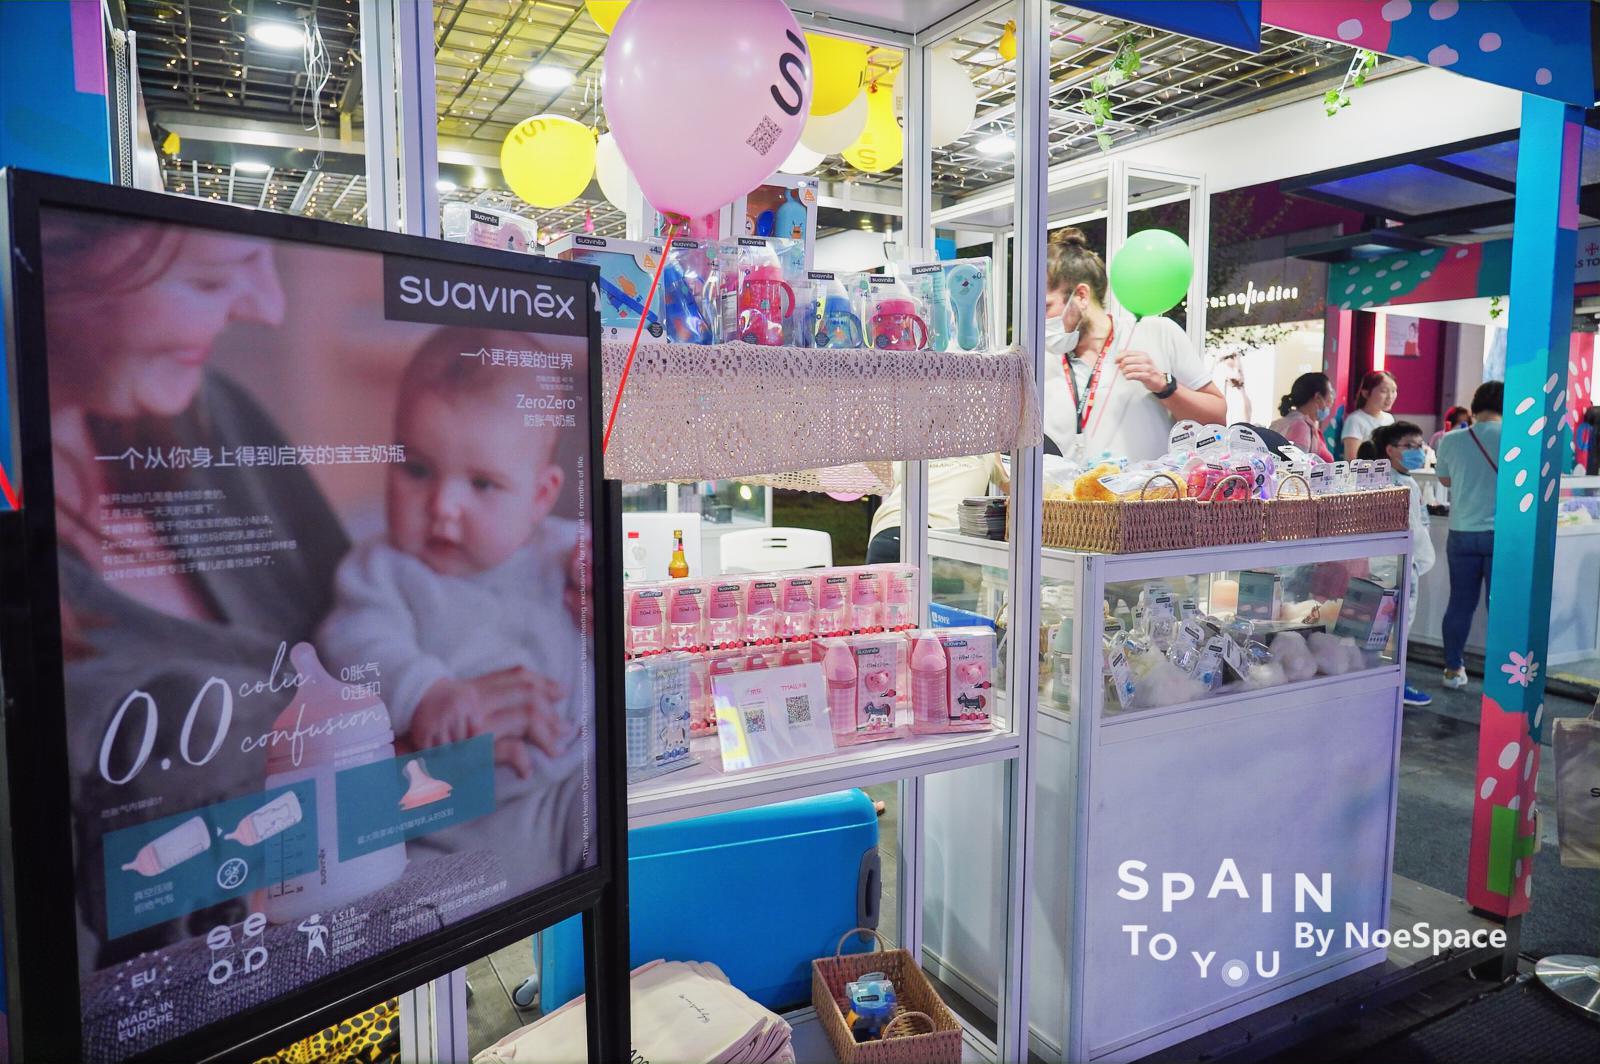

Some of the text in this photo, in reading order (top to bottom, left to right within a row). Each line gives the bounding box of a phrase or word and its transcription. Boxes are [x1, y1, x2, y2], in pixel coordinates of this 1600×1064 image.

[460, 348, 574, 370] 一个更有爱的世界
[94, 444, 406, 470] 一个从你身上得到启发的宝宝奶瓶
[577, 480, 585, 509] months
[577, 519, 585, 533] first
[341, 681, 381, 701] 0违和
[131, 968, 157, 989] EU
[117, 1000, 174, 1030] MADE IN
[118, 1012, 175, 1042] EUROPE
